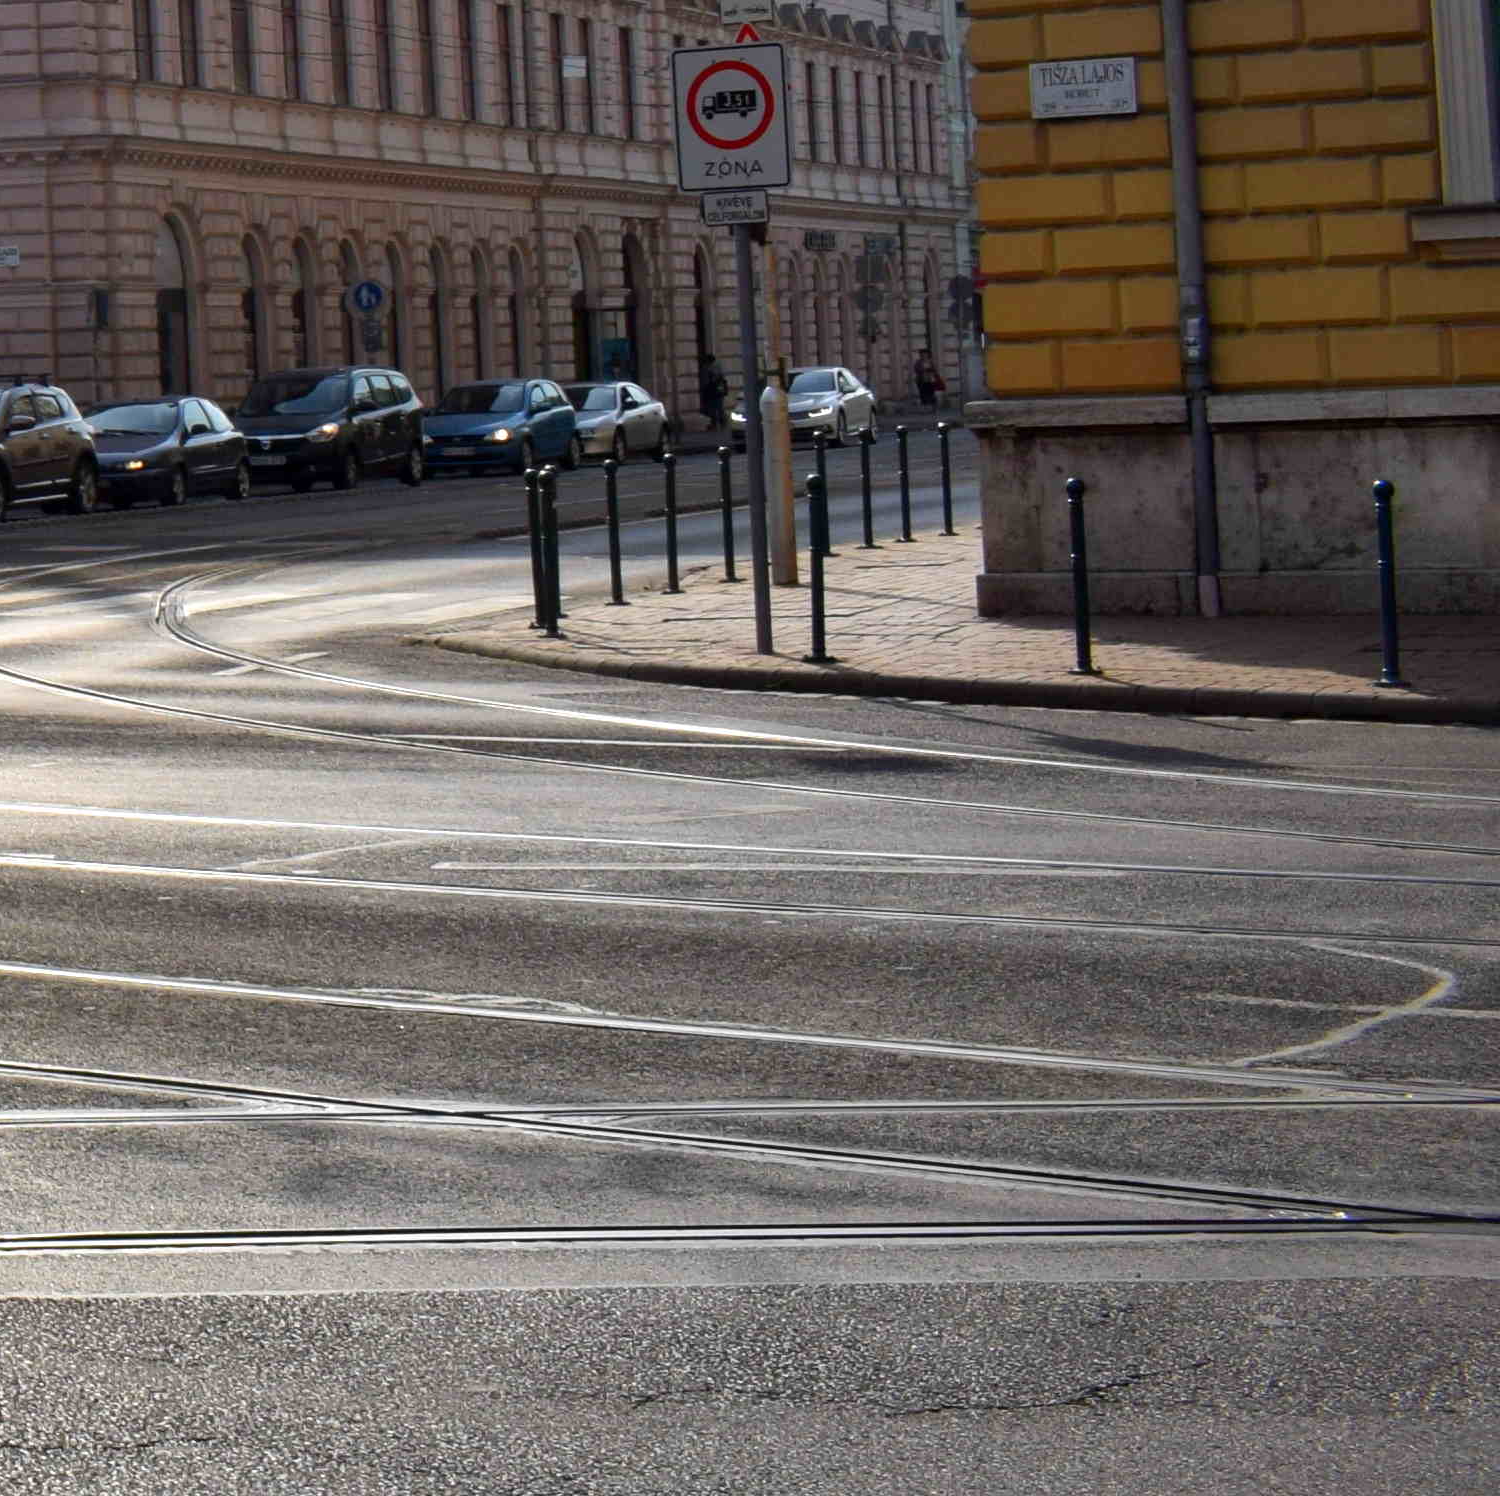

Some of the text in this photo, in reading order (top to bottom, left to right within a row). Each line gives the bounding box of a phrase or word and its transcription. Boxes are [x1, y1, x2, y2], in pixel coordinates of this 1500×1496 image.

[1040, 63, 1125, 88] TISZA LAJOS
[704, 157, 764, 178] ZÓNA
